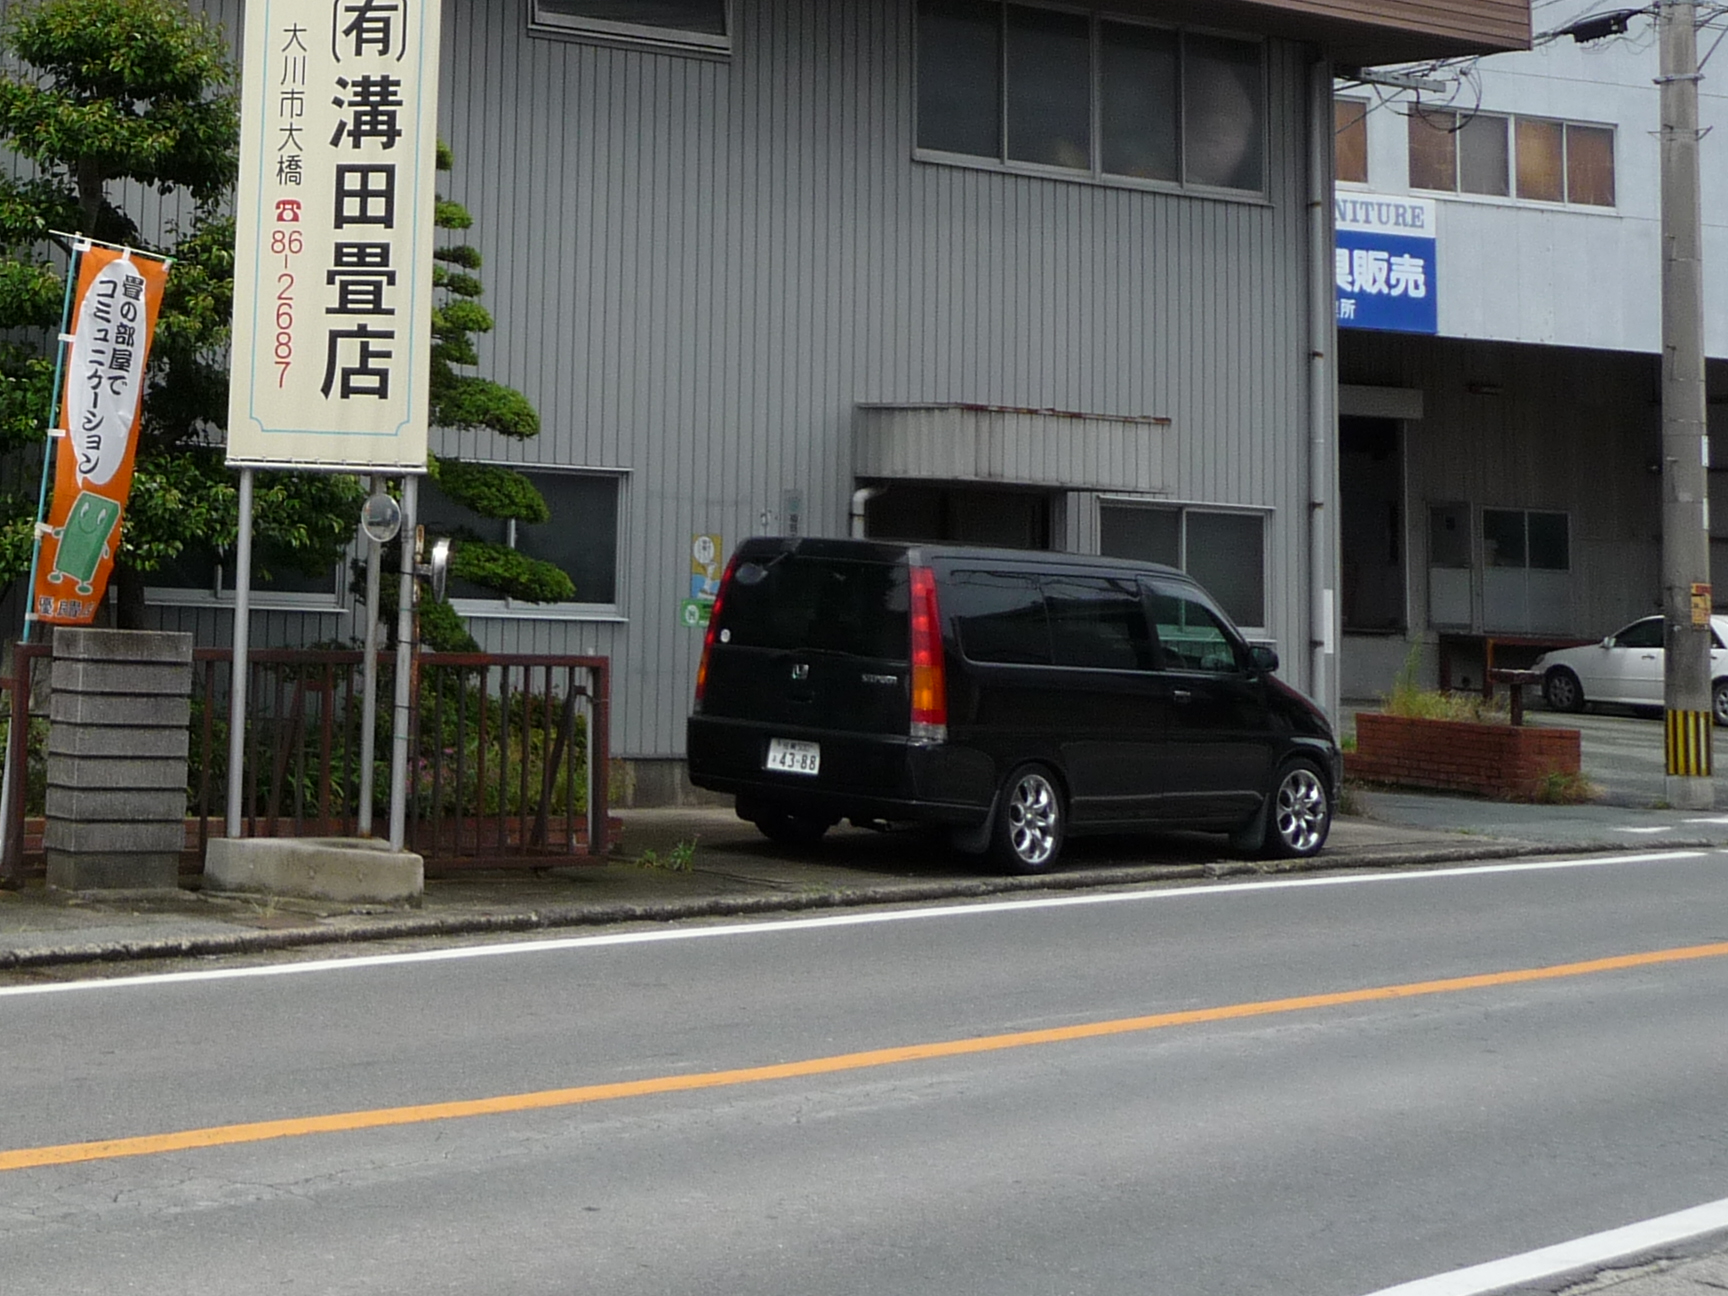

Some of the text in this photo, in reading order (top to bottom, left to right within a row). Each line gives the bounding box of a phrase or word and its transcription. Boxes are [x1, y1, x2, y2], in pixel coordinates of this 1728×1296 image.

[271, 22, 308, 388] 大川市大橋 86-2687
[108, 274, 145, 396] 畳の部屋で
[1335, 298, 1356, 320] 所
[78, 279, 118, 475] コミュニケーション
[779, 751, 817, 771] 43-88
